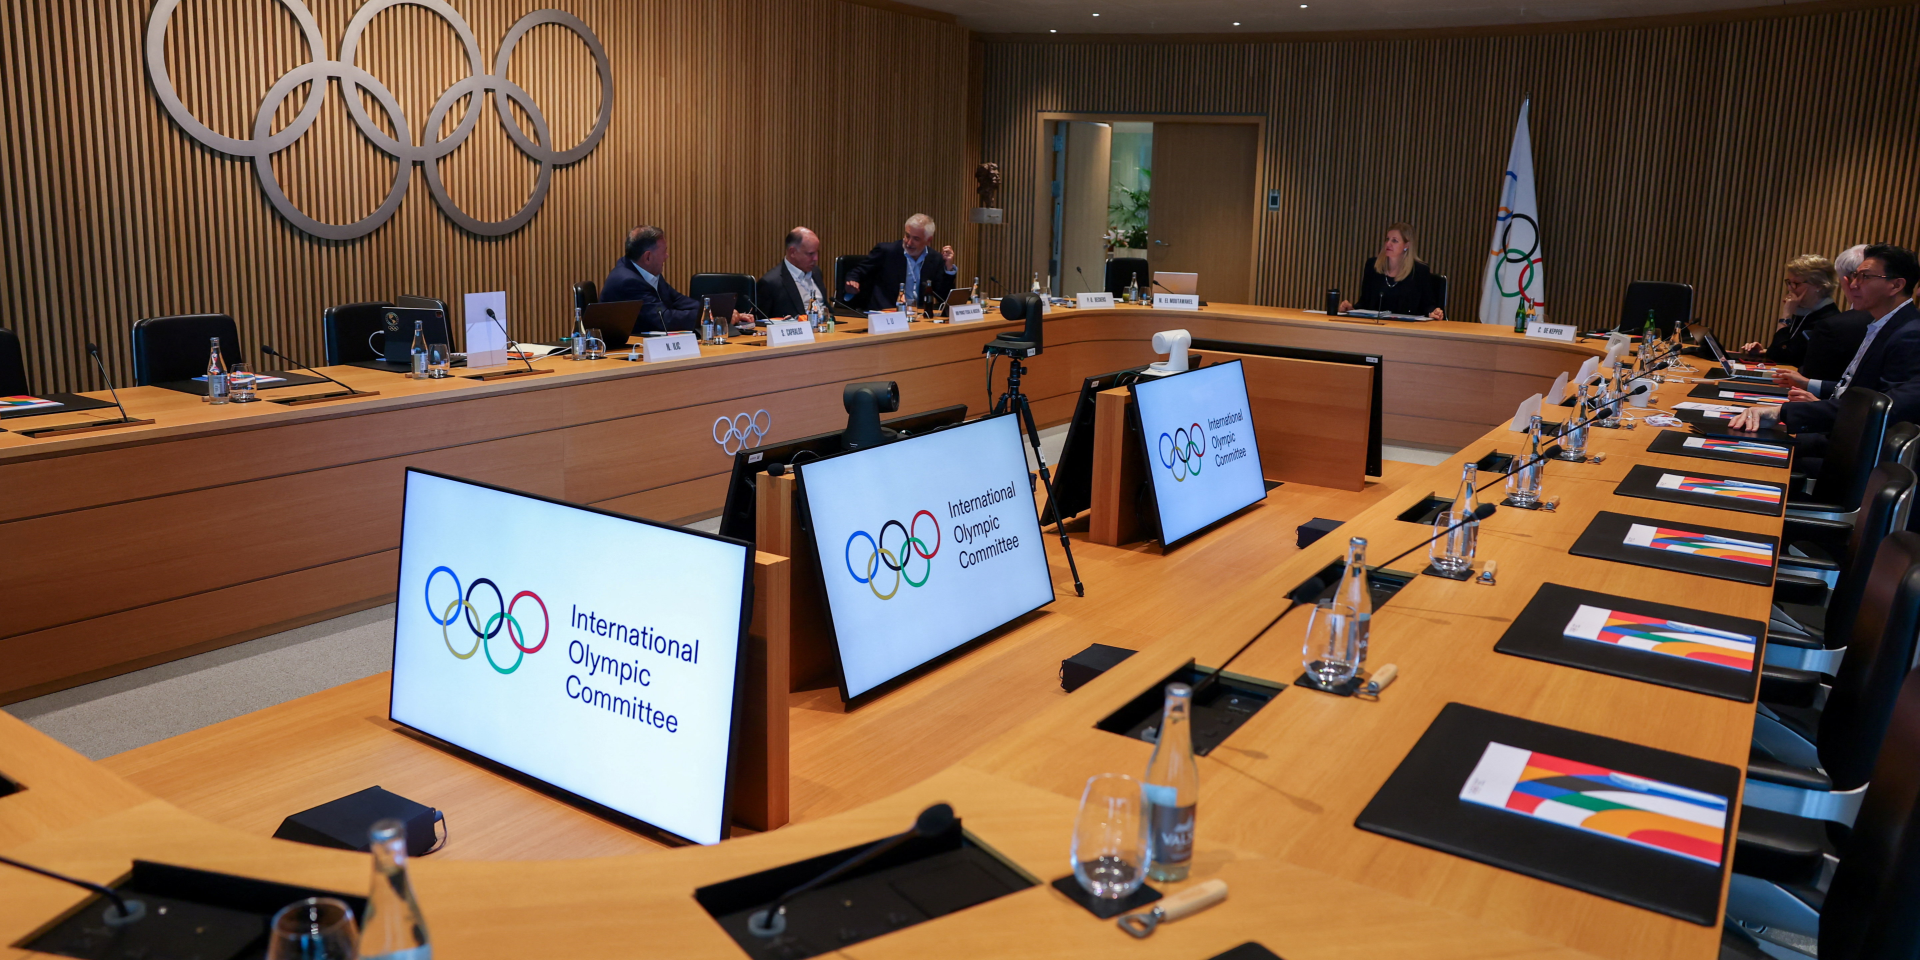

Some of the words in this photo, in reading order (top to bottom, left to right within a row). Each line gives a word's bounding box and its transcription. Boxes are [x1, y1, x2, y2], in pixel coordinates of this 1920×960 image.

[1549, 327, 1564, 336] KEPPER
[1207, 408, 1243, 431] International
[1211, 431, 1236, 450] Olympic
[1215, 447, 1247, 467] Committee
[948, 481, 1017, 518] International
[953, 514, 1000, 545] Olympic
[959, 535, 1020, 569] Committee
[571, 604, 699, 664] International
[568, 640, 651, 686] Olympic
[566, 674, 678, 733] Committee
